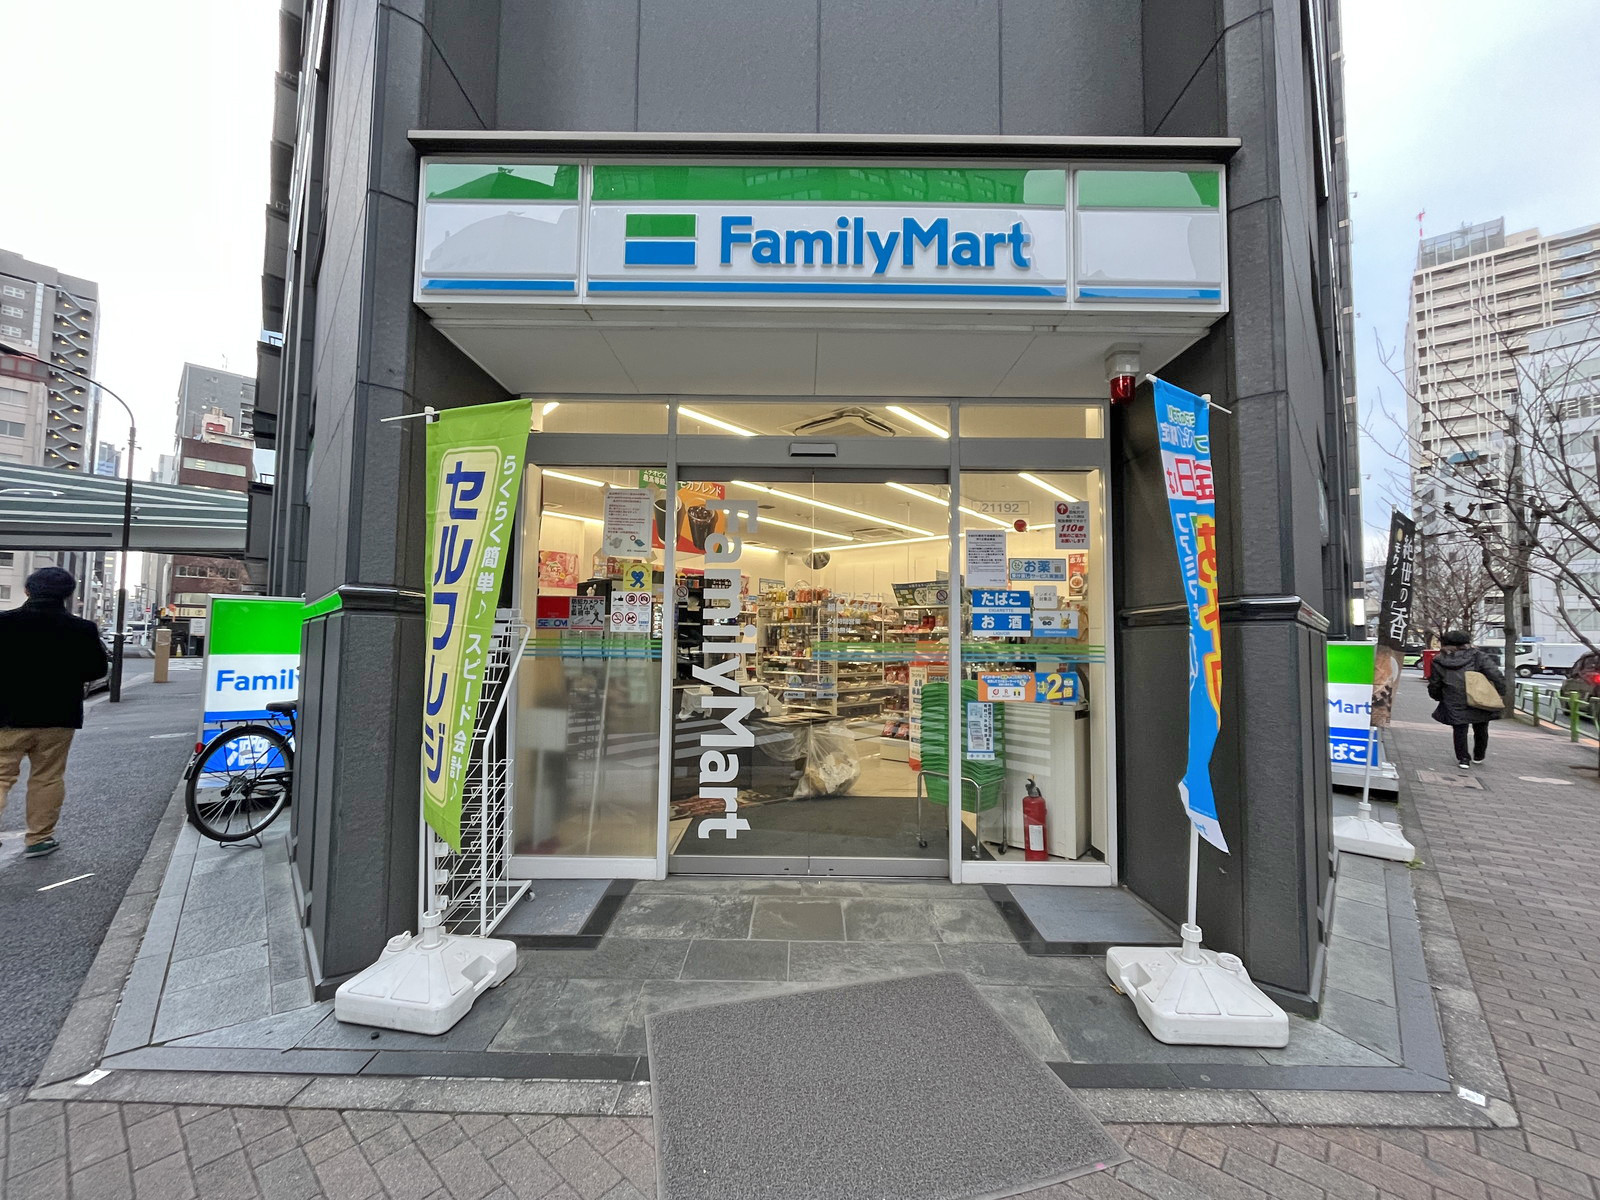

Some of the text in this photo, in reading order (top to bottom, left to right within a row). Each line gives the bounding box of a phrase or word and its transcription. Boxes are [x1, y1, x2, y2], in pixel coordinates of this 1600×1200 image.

[720, 216, 1031, 274] FamilyMart
[678, 480, 722, 497] モカブレンド
[981, 502, 1020, 513] 21192
[1024, 560, 1051, 573] お薬
[981, 591, 1021, 606] たばこ
[426, 460, 486, 784] セルフレジ
[537, 618, 568, 627] SECOM
[981, 615, 1023, 629] お酒
[692, 500, 758, 839] FamilyMart
